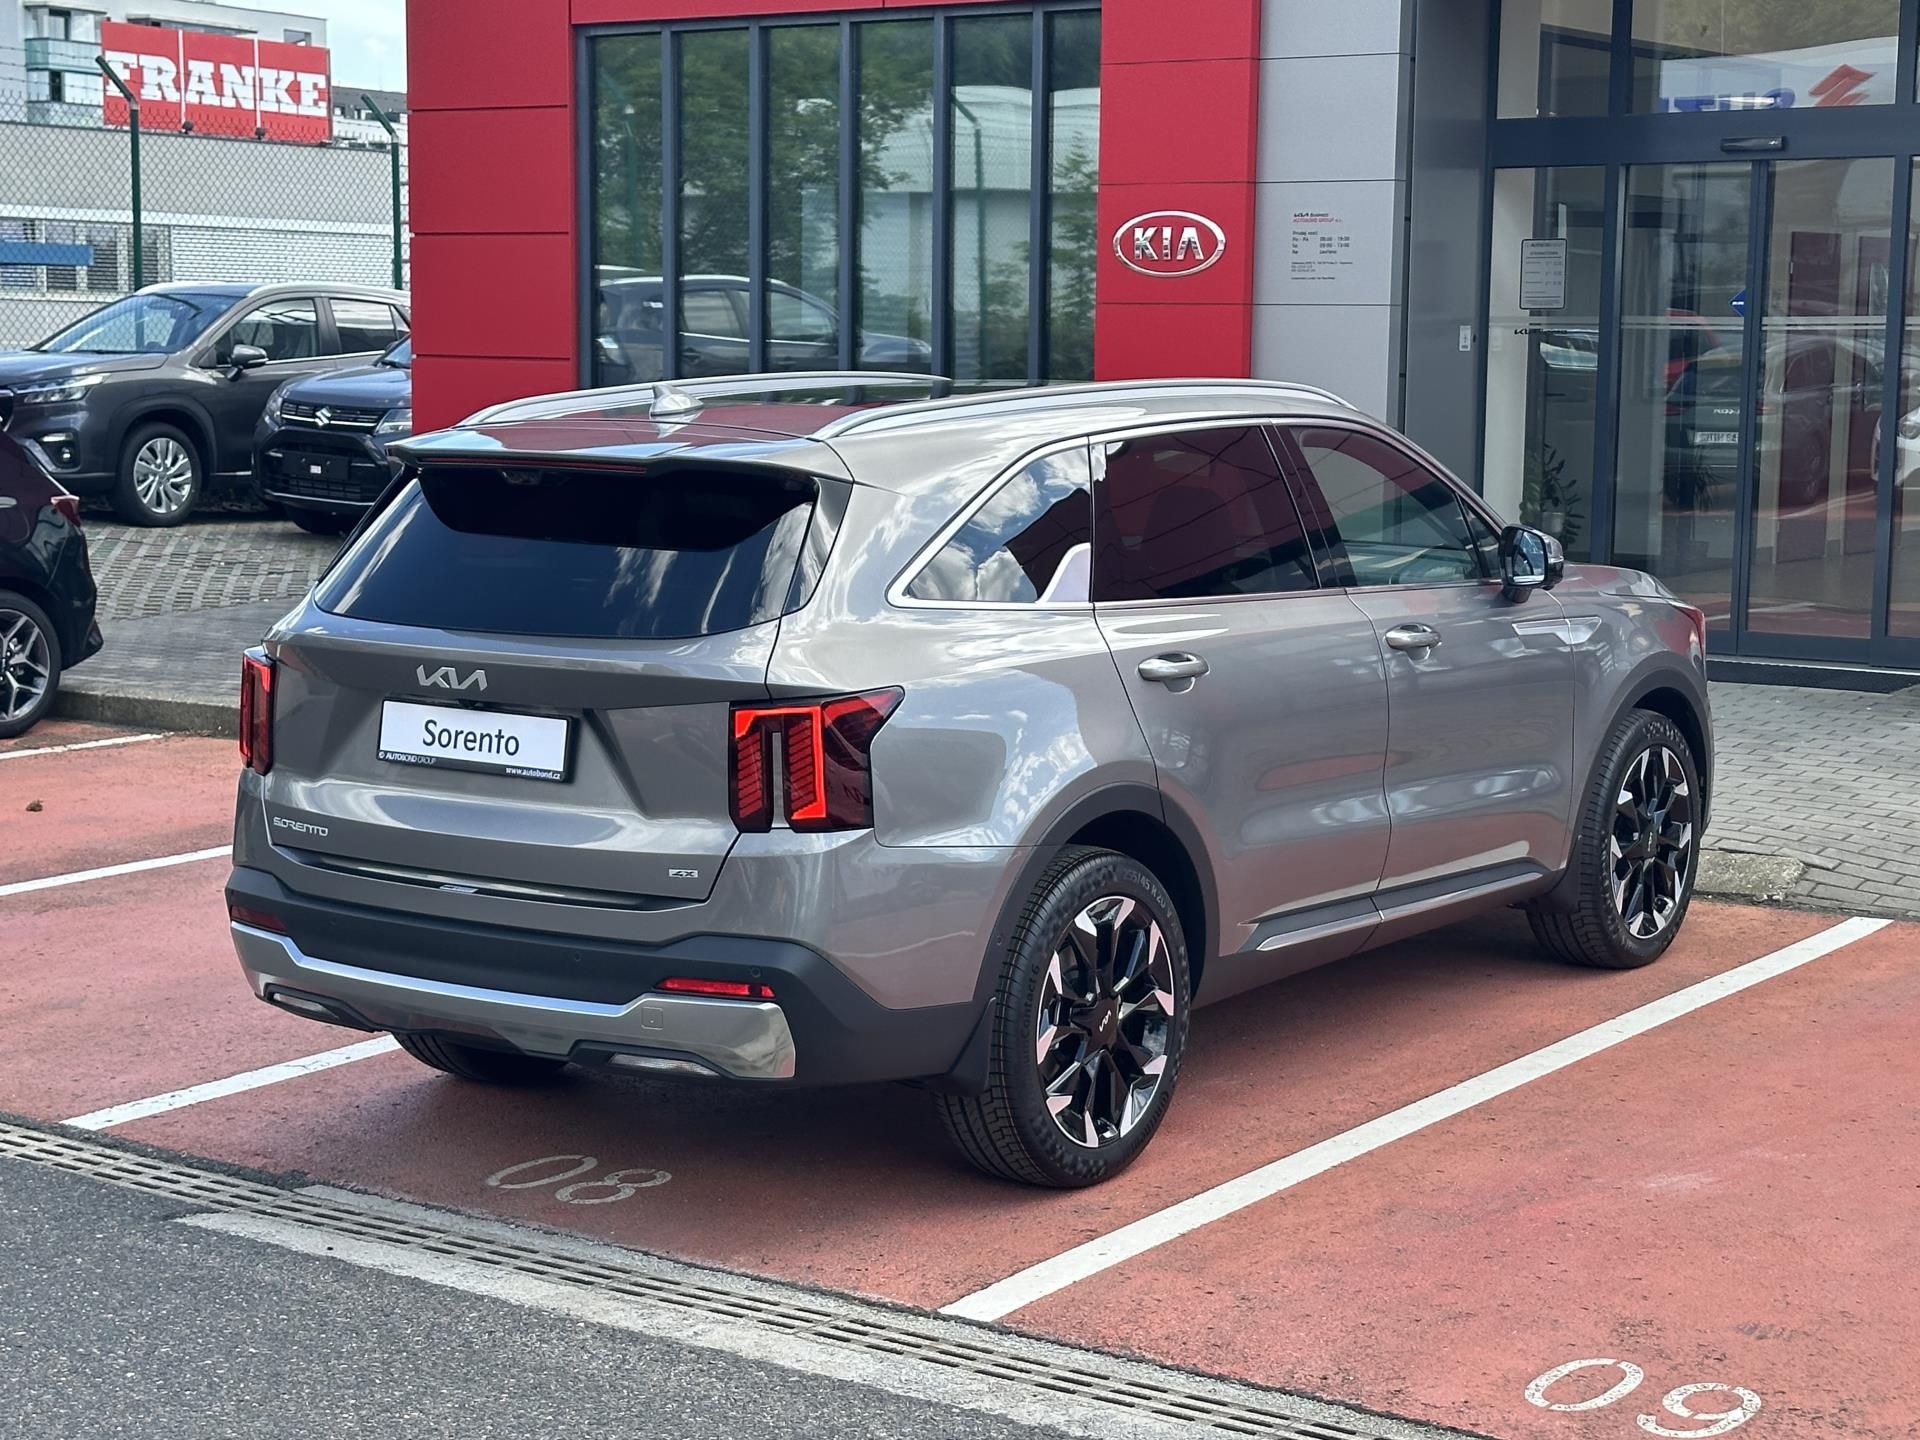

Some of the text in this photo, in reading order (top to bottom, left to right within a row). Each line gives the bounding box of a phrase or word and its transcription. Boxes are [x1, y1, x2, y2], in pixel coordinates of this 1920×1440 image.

[104, 50, 327, 117] FRANKE
[1134, 226, 1204, 261] KIA
[416, 664, 488, 692] KIA
[422, 719, 520, 757] Sorento
[385, 752, 418, 763] AUTOBOND
[505, 767, 561, 780] www.autobond.cz
[273, 816, 329, 837] SORENTO
[485, 1155, 673, 1205] 08
[1524, 1358, 1762, 1438] 09
